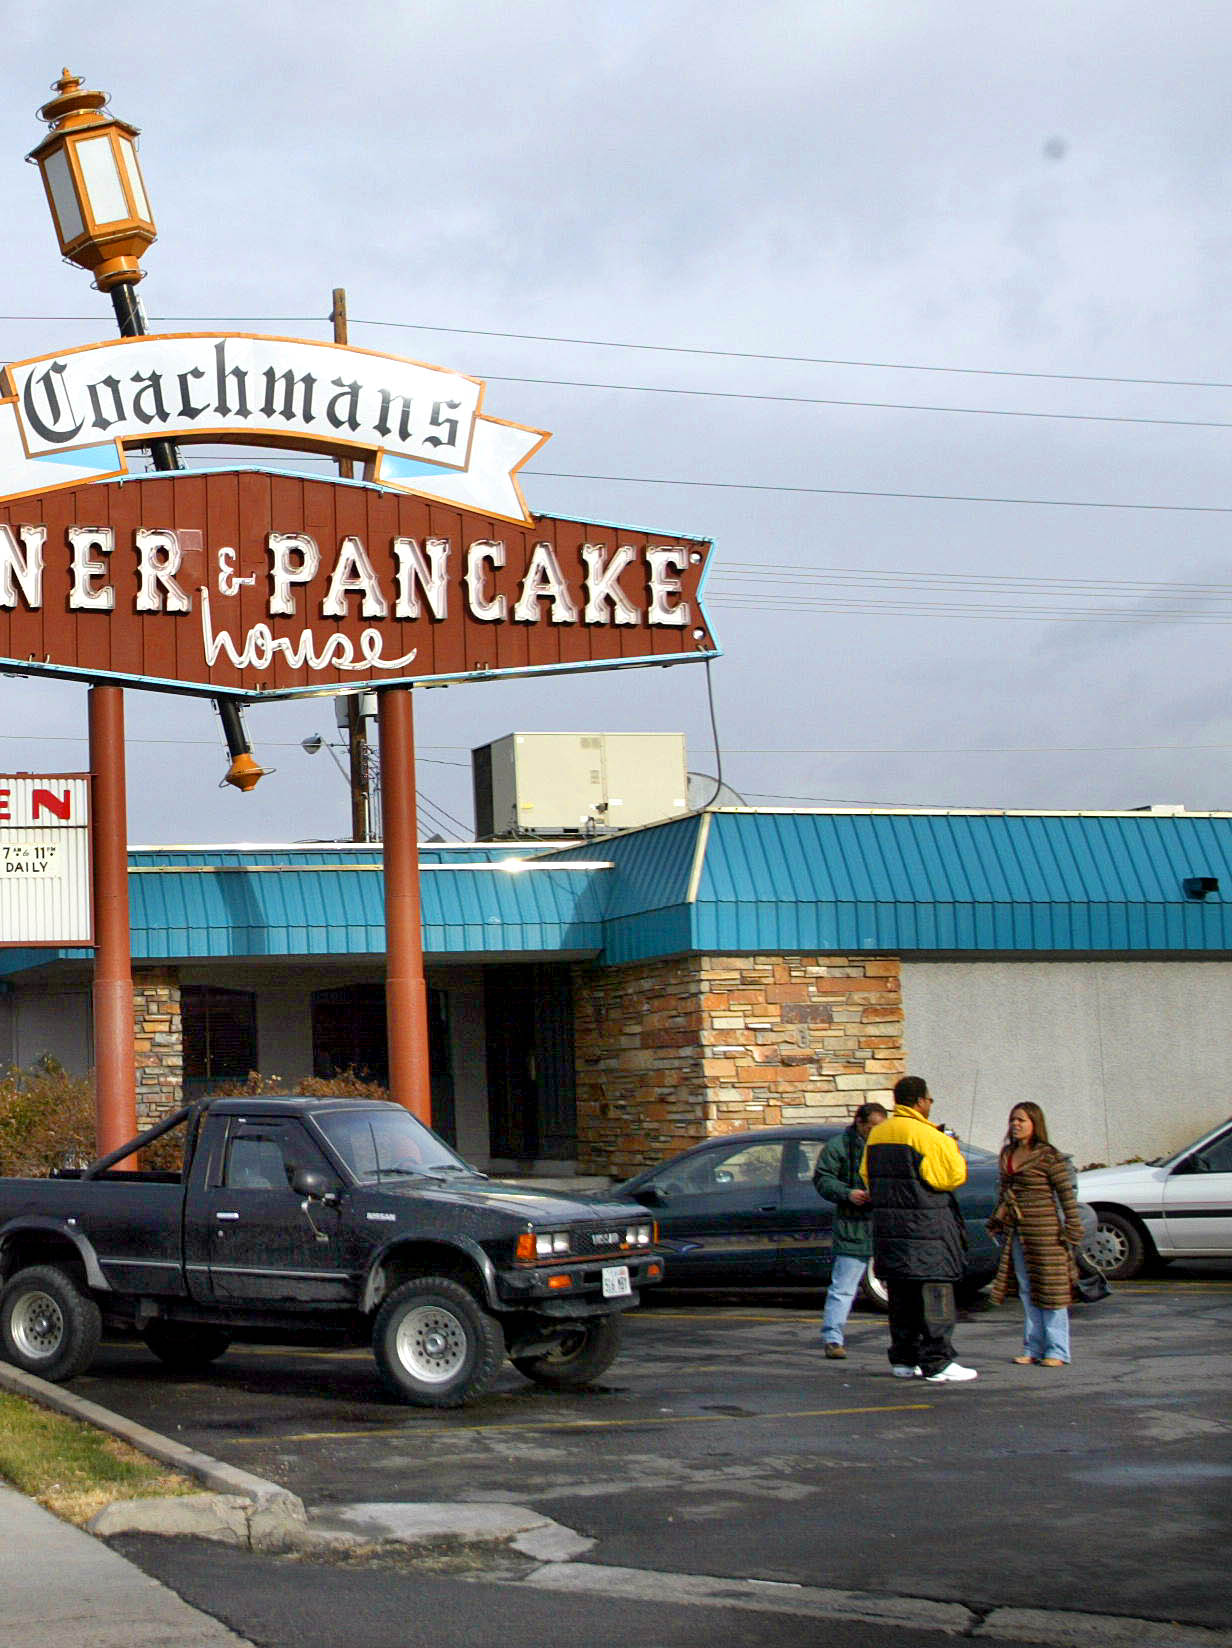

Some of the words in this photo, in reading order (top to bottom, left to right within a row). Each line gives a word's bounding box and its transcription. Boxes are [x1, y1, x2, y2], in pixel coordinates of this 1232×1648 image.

[23, 338, 462, 449] Coachmans
[218, 545, 256, 597] &
[268, 532, 693, 627] PANCAKE
[201, 585, 418, 671] house
[6, 861, 48, 873] DAILY
